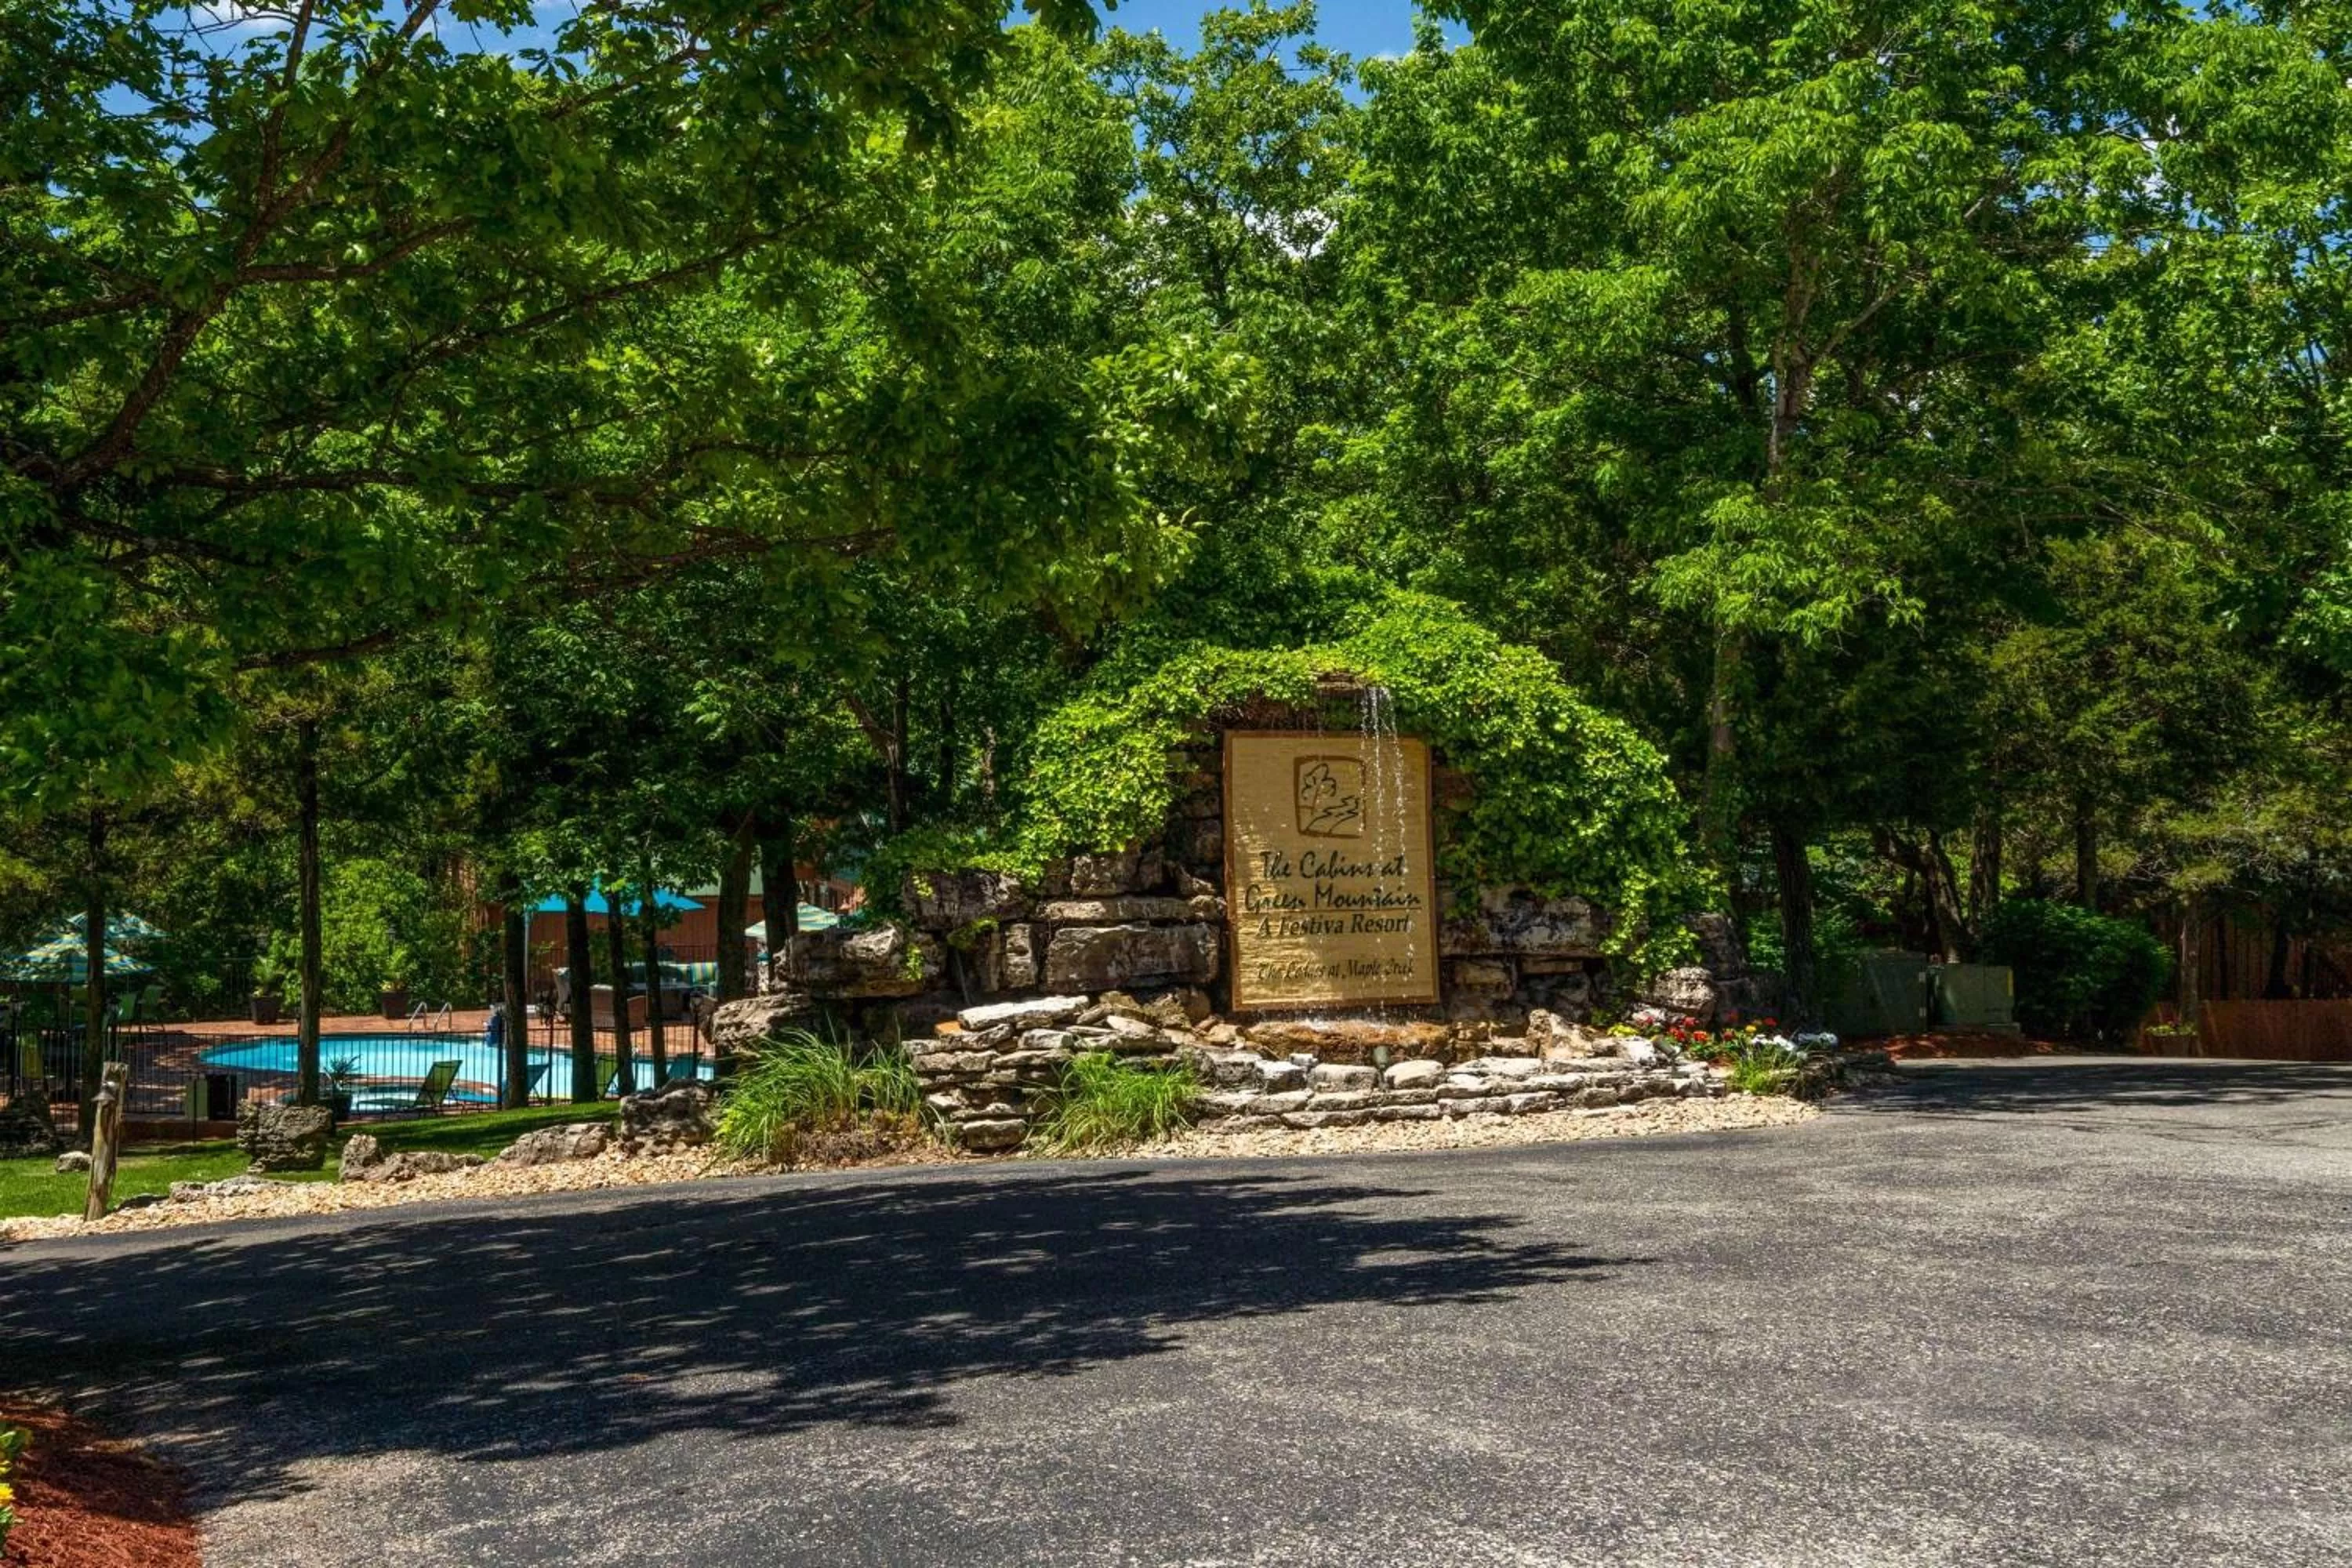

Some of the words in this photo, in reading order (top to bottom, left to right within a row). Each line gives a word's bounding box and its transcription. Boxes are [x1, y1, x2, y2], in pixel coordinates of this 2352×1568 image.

[1260, 851, 1291, 879] The
[1300, 851, 1374, 879] Cabins
[1381, 852, 1405, 877] at
[1245, 884, 1307, 914] Green
[1315, 880, 1421, 909] Mountain
[1256, 915, 1272, 938] A
[1279, 914, 1344, 937] Festiva
[1350, 913, 1410, 934] Resort
[1342, 959, 1381, 978] Maple
